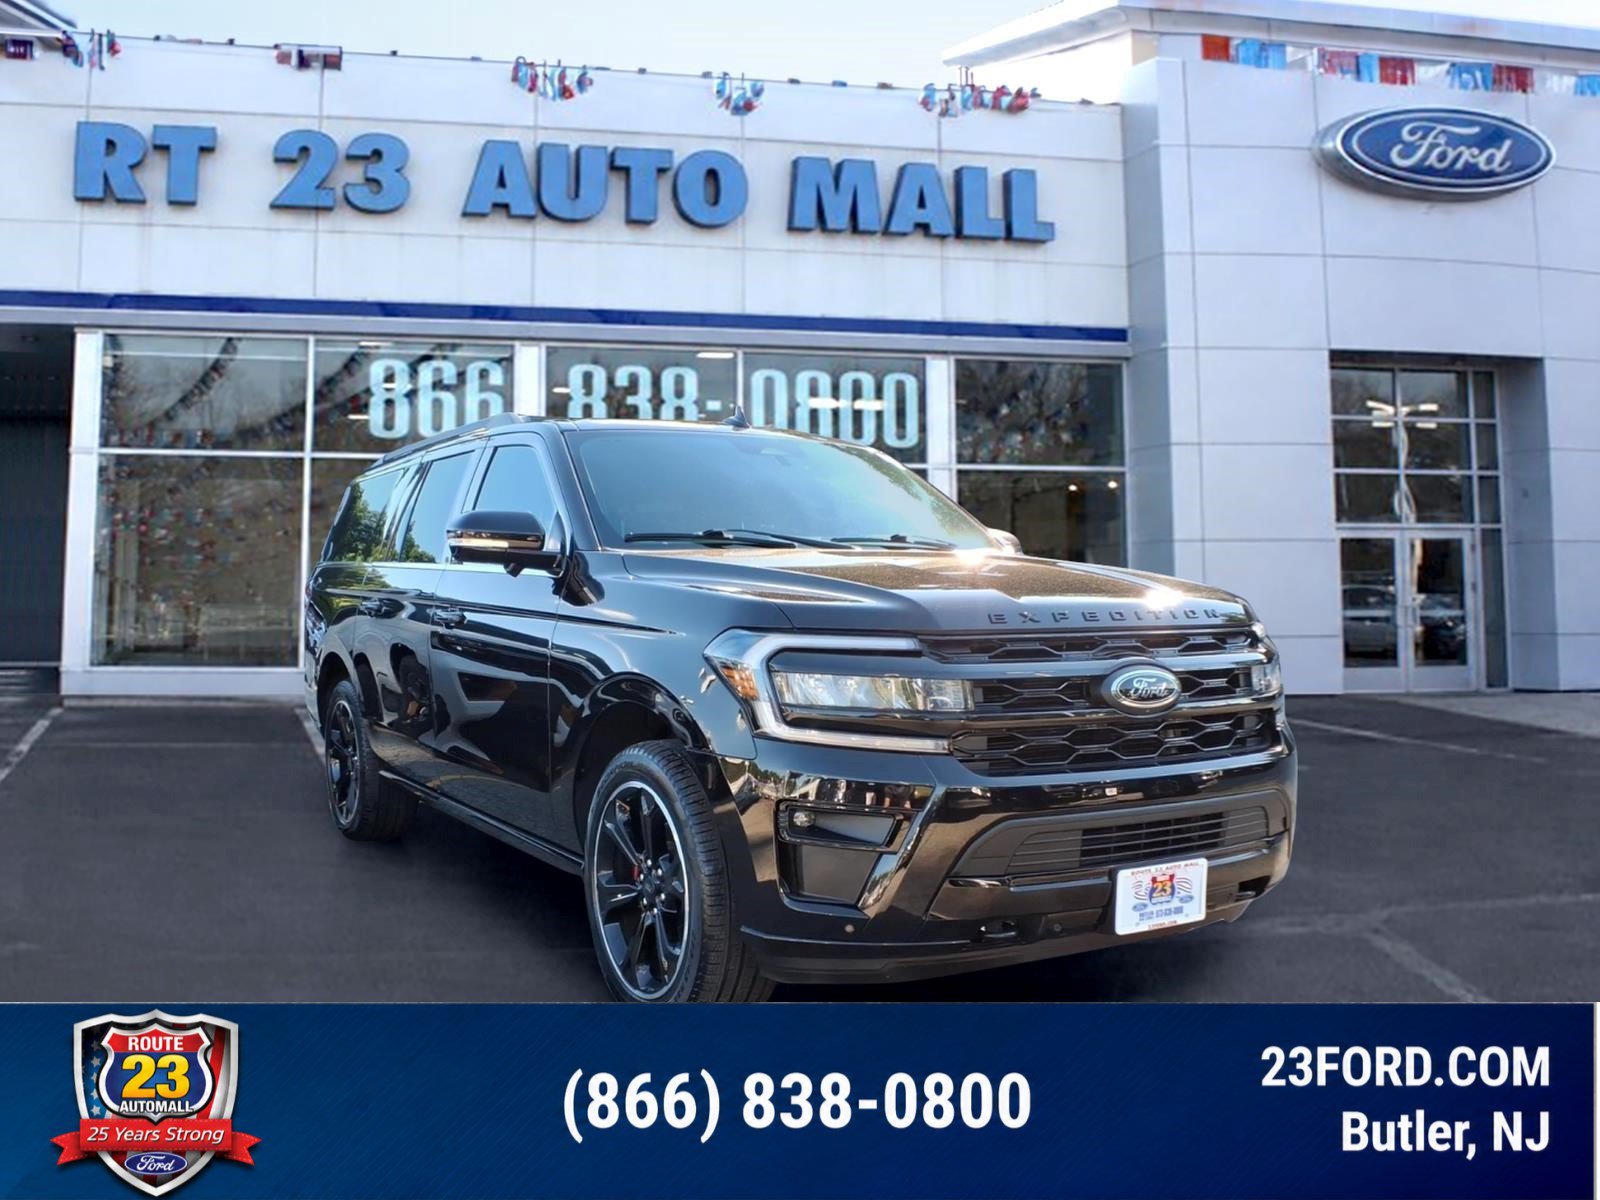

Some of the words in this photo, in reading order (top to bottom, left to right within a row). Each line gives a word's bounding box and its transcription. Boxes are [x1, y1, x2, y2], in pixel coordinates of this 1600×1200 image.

[1390, 121, 1512, 172] Ford
[73, 120, 217, 205] RT
[270, 129, 410, 214] 23
[462, 140, 748, 229] AUTO
[788, 156, 1055, 244] MALL
[369, 358, 504, 439] 866
[988, 608, 1220, 625] EXPEDITION
[1128, 677, 1168, 699] Ford
[1153, 882, 1172, 898] 23
